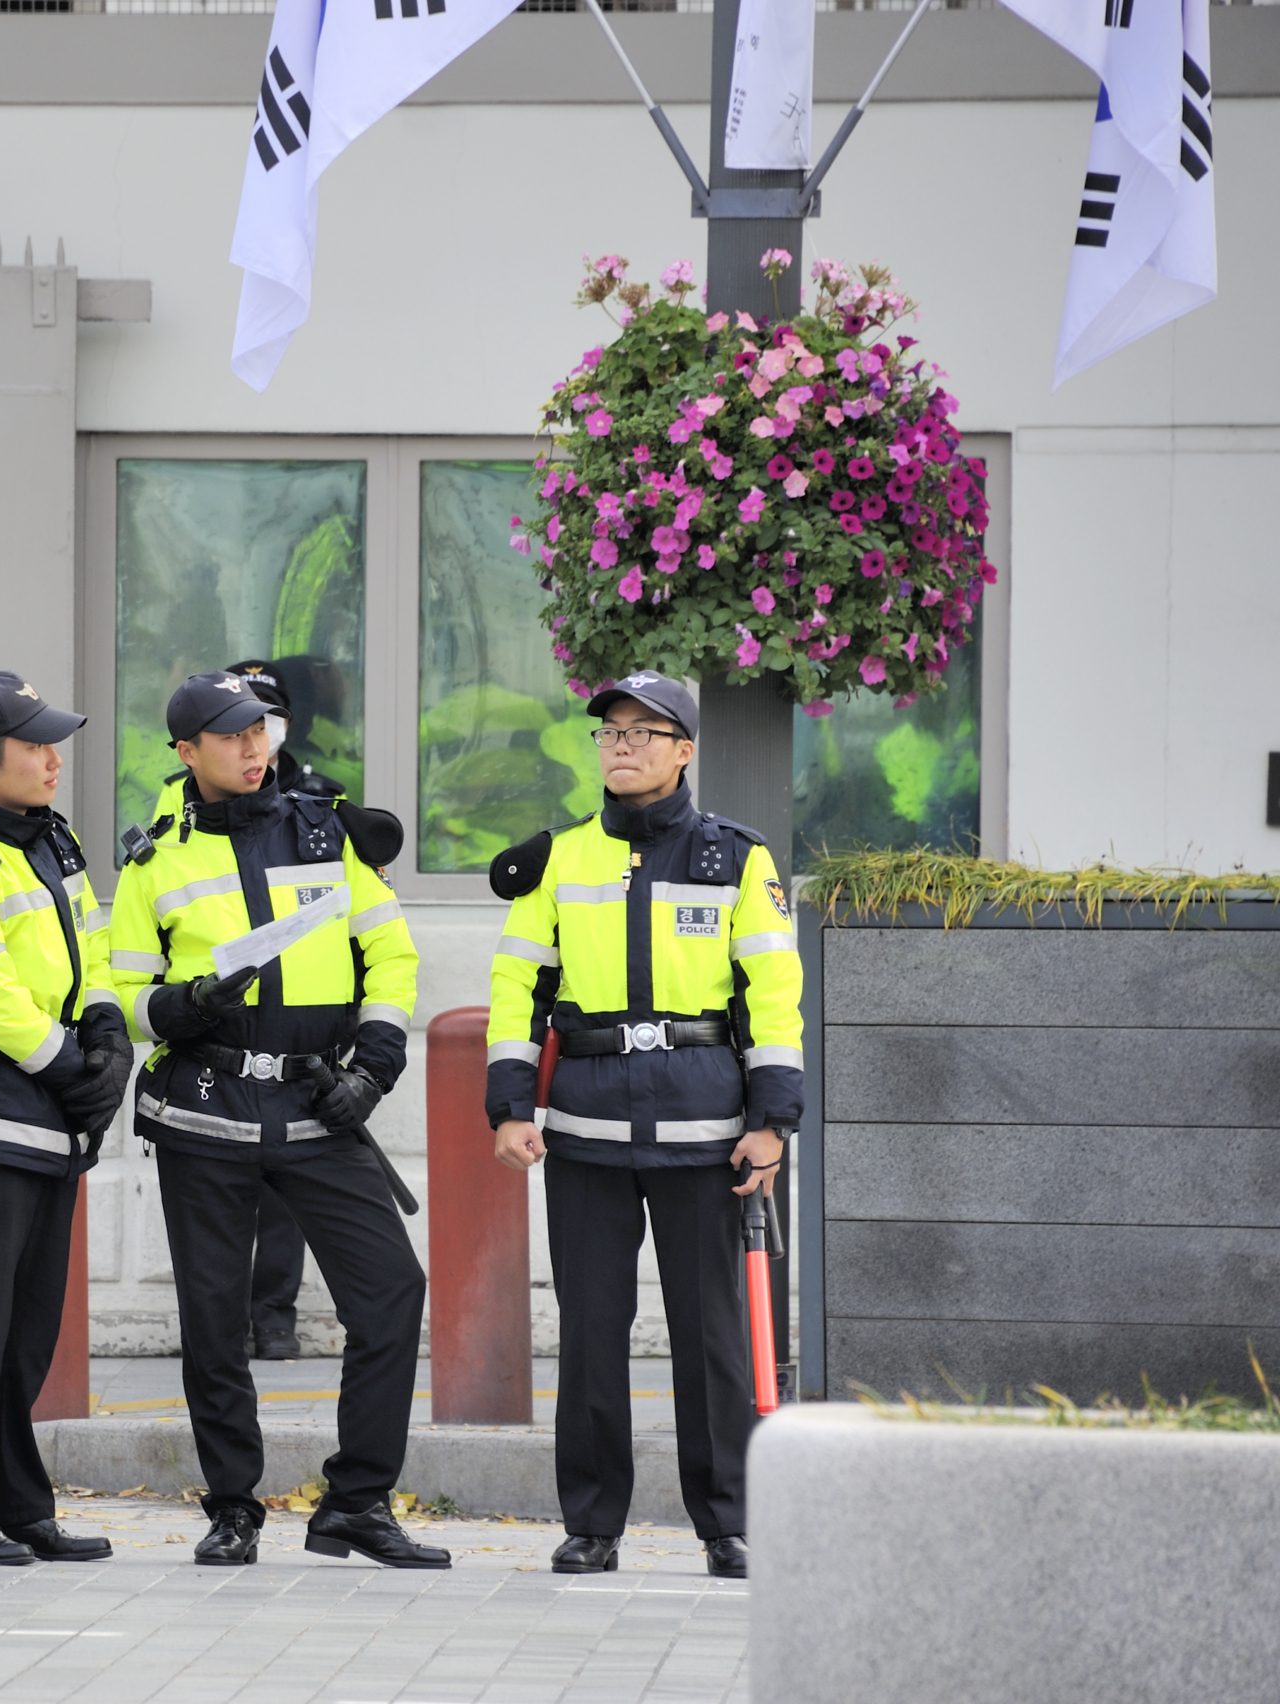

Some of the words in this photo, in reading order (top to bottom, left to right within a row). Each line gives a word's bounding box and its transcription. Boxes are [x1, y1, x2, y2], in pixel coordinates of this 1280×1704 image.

[240, 674, 277, 687] OLICE
[679, 908, 716, 924] 경찰
[679, 926, 716, 934] POLICE
